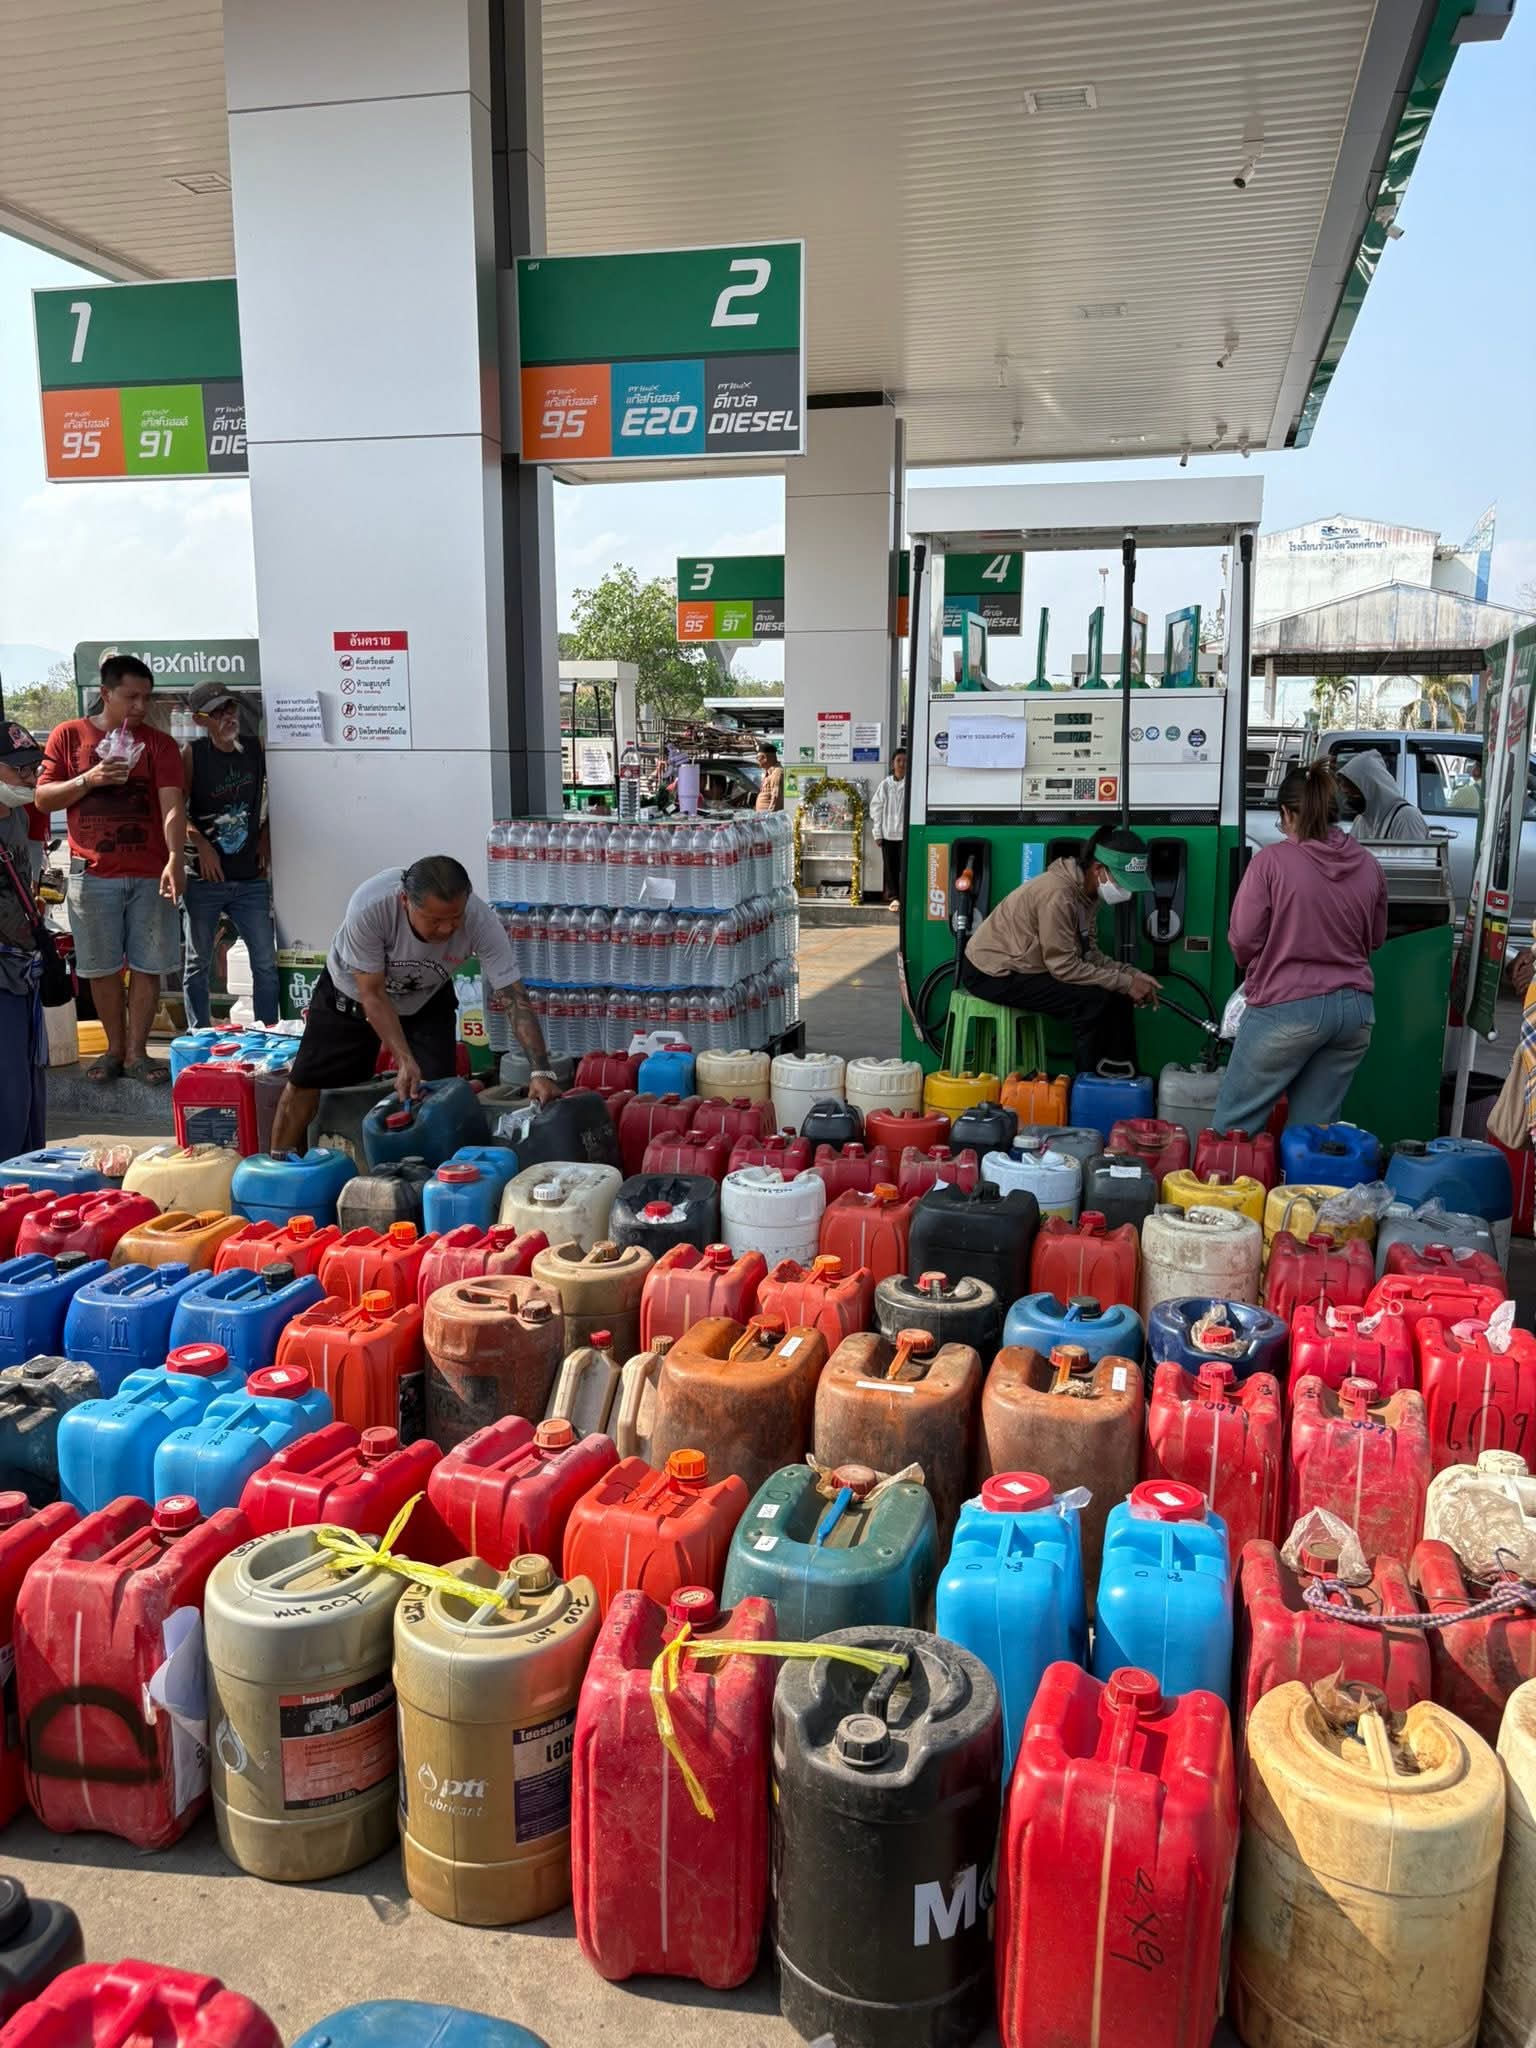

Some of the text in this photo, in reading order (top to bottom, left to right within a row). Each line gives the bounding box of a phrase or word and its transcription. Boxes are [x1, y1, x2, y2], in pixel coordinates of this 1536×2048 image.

[710, 257, 772, 328] 2
[69, 302, 92, 364] 1
[713, 392, 758, 409] ดีเซล
[540, 409, 588, 439] 95
[620, 405, 698, 436] E20
[707, 410, 799, 434] DIESEL
[61, 431, 101, 459] 95
[138, 430, 173, 458] 91
[209, 434, 247, 456] DIE
[690, 563, 714, 591] 3
[981, 553, 1010, 584] 4
[684, 619, 705, 633] 95
[721, 619, 740, 632] 91
[988, 618, 1020, 629] IESEL
[350, 633, 391, 647] อันตราย
[439, 1778, 488, 1798] ptt
[423, 1794, 483, 1817] Lubricant
